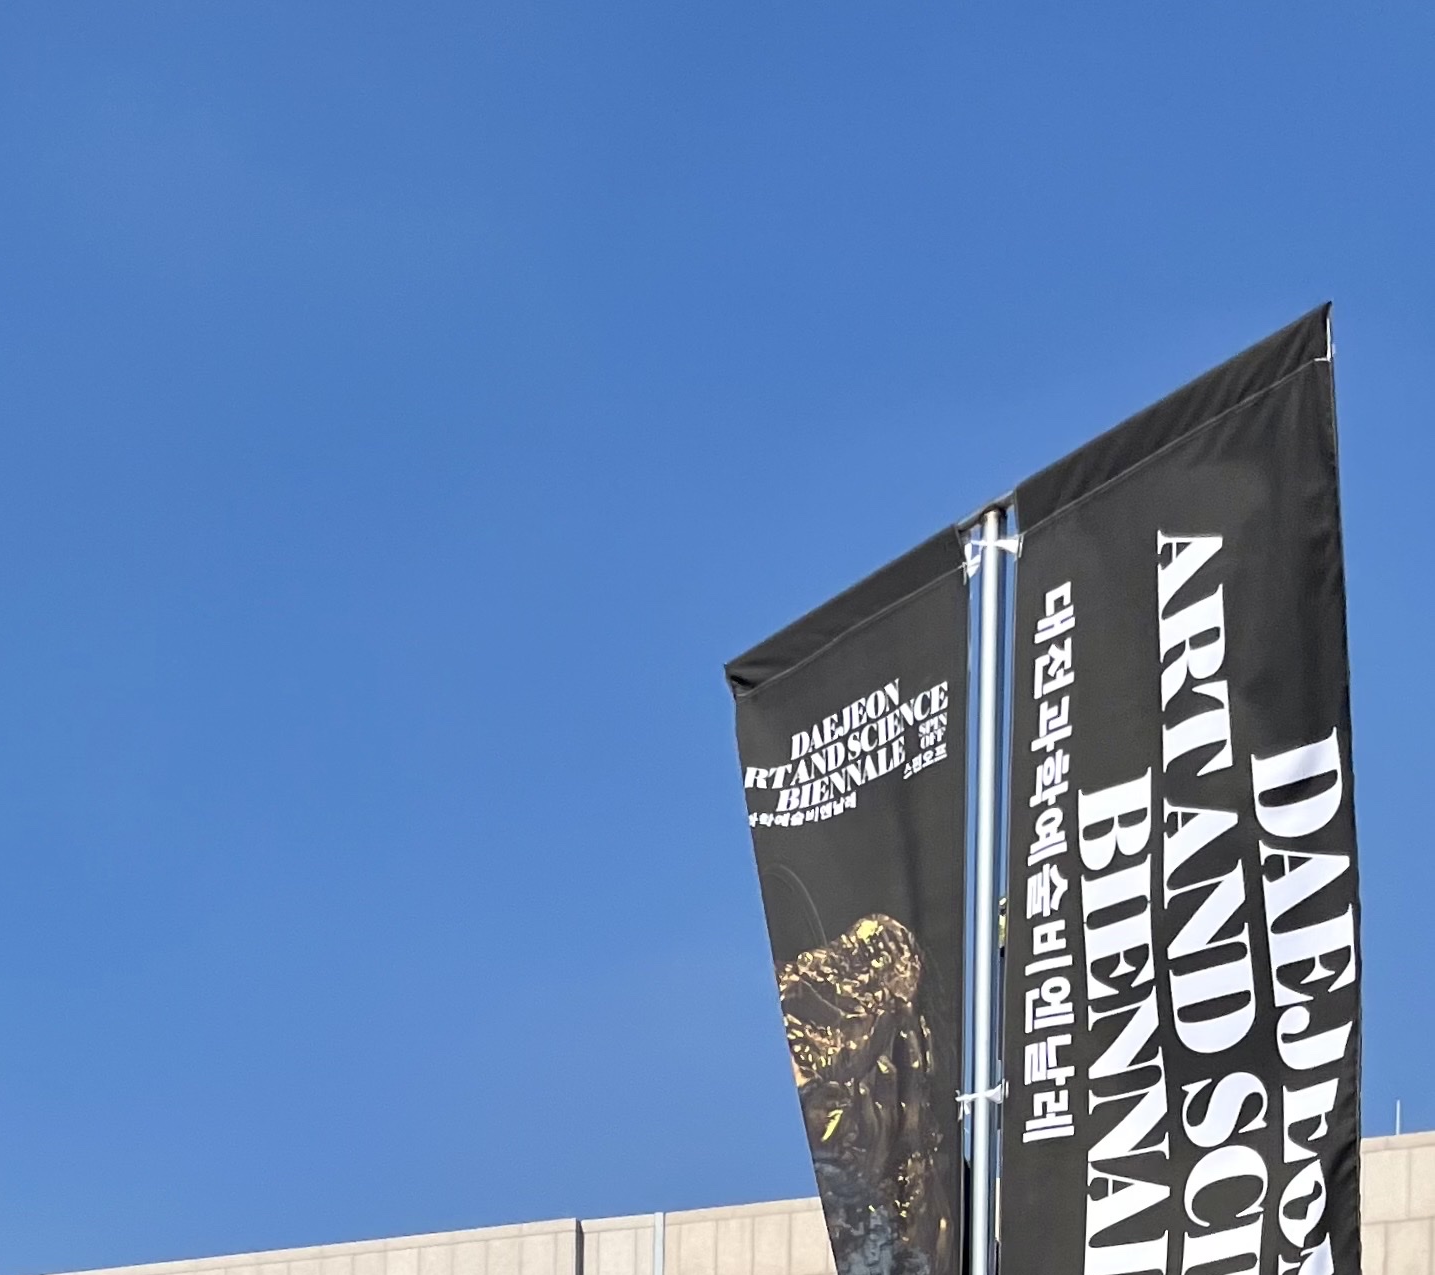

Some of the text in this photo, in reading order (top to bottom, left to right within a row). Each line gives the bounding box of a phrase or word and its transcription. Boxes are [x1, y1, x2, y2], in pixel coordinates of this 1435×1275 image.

[1156, 529, 1234, 776] ART
[790, 678, 900, 760] DAEJEON
[790, 741, 846, 786] AND
[847, 681, 949, 762] SCIENCE
[902, 743, 948, 780] 스핀오프
[776, 736, 906, 813] BIENNALE
[1022, 581, 1076, 1143] 대전과학예술비엔날레
[1162, 797, 1258, 1054] AND
